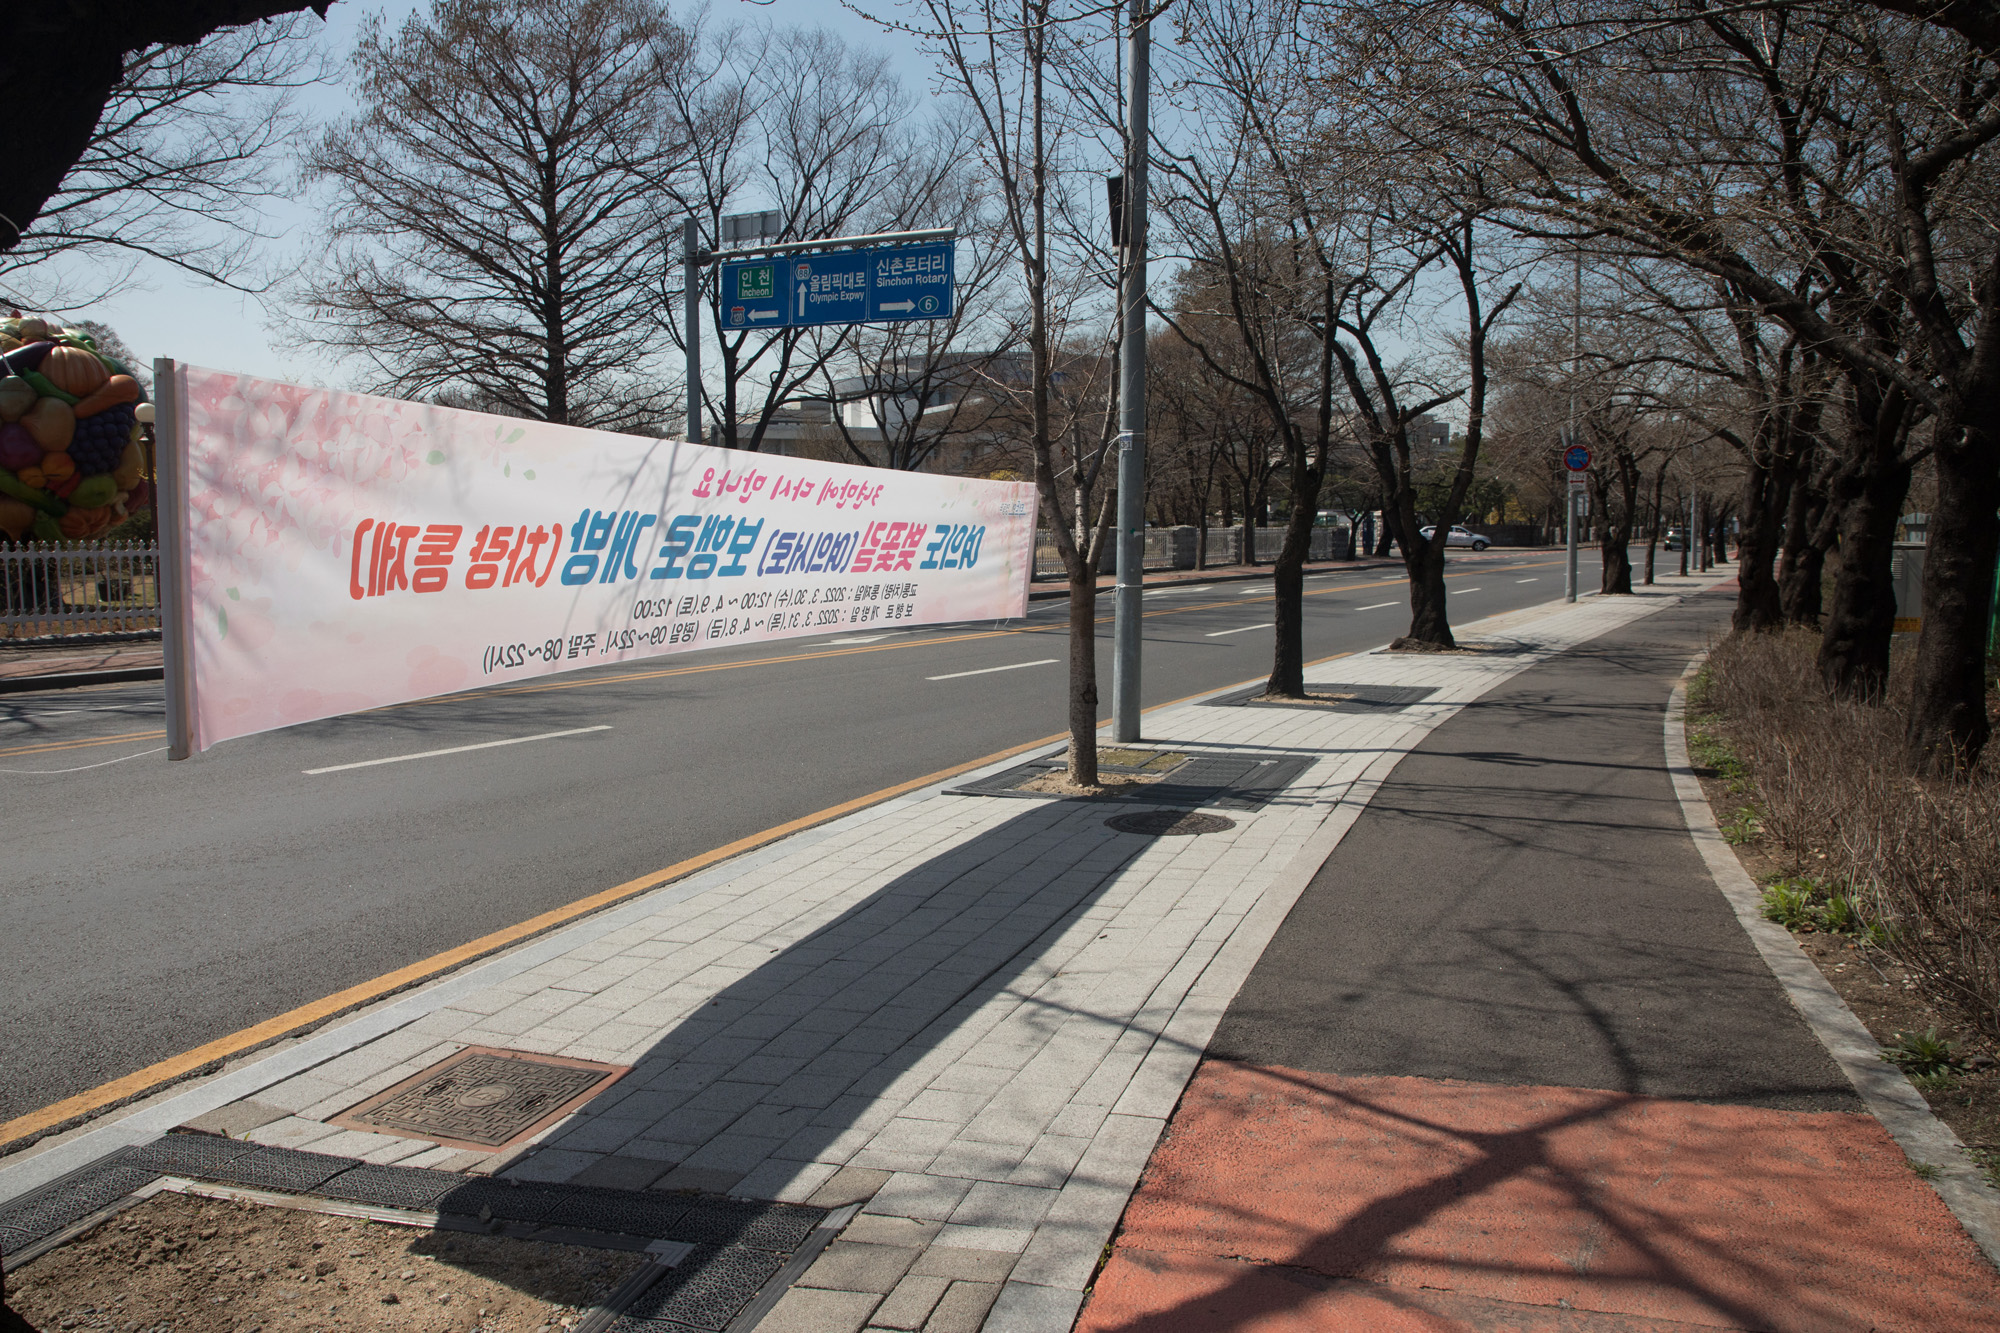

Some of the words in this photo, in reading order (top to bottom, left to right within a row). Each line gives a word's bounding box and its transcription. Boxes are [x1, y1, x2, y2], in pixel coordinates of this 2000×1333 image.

[876, 253, 946, 277] 신촌로터리
[799, 269, 808, 277] 88
[876, 275, 913, 287] Sinchon
[915, 273, 948, 285] Rotary
[809, 271, 866, 292] 올림픽대로
[741, 286, 770, 297] Incheon
[809, 291, 839, 304] Olympic
[840, 290, 865, 302] Expwy
[925, 299, 932, 311] 6
